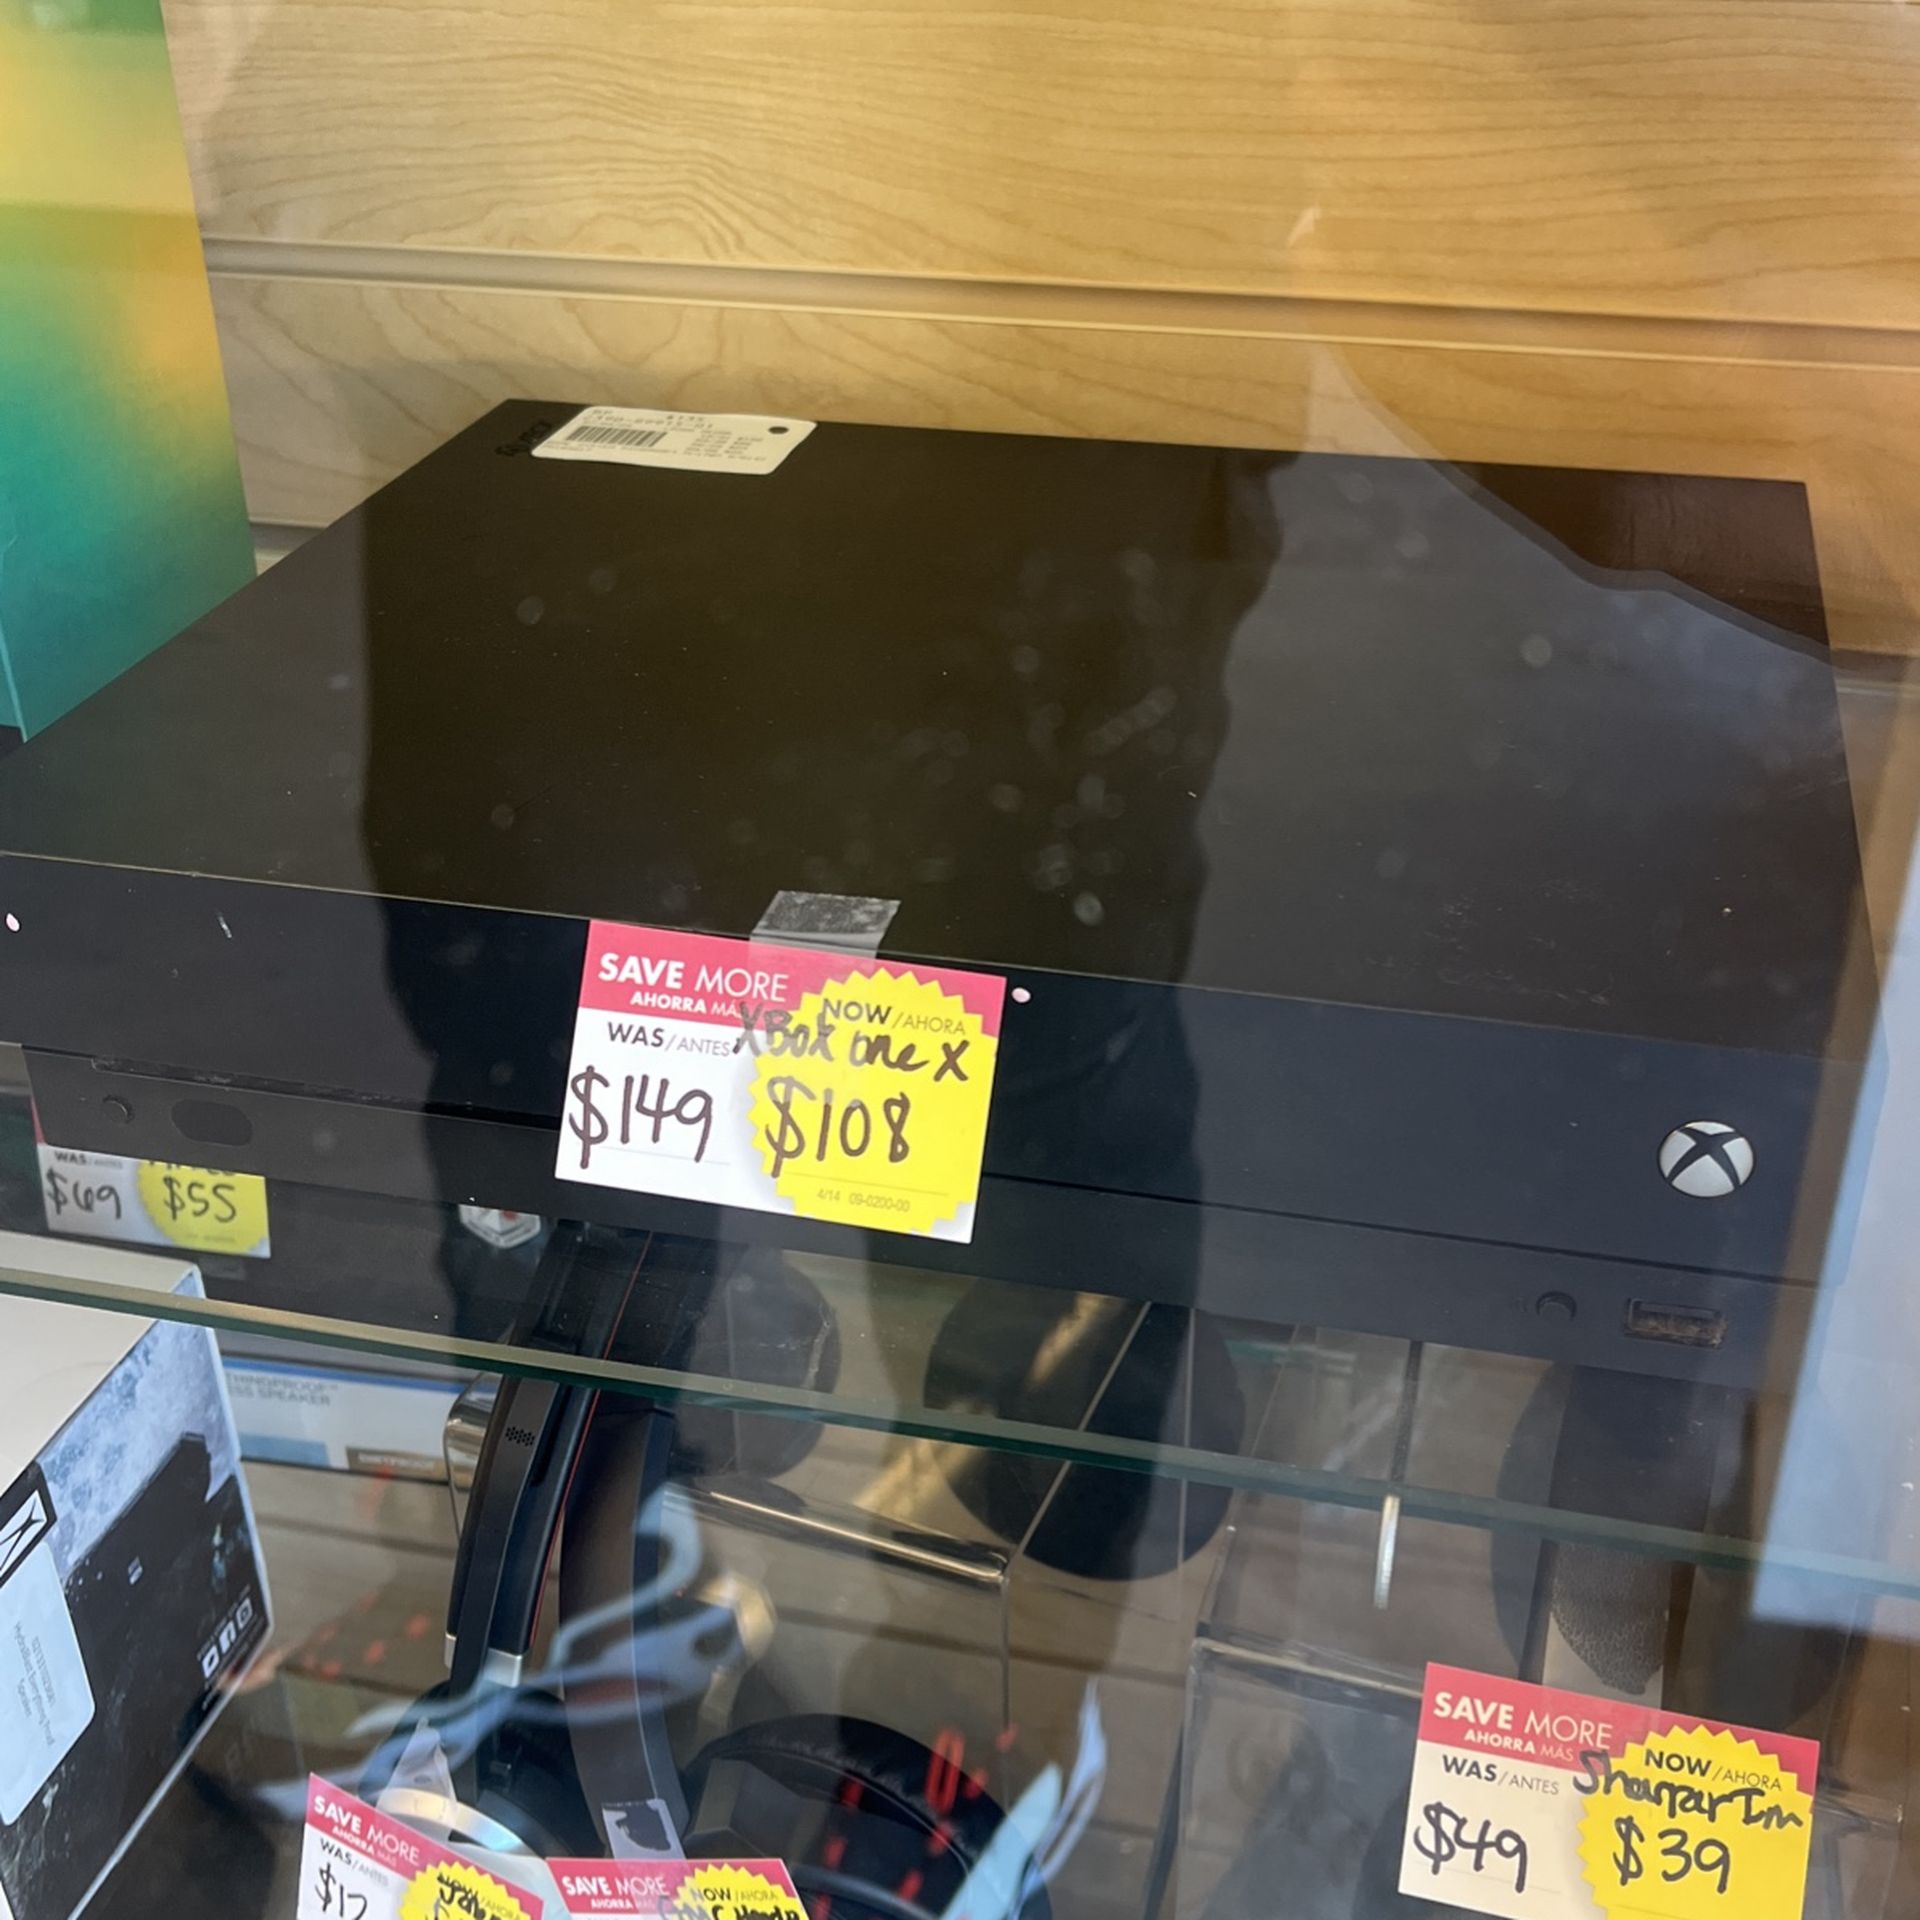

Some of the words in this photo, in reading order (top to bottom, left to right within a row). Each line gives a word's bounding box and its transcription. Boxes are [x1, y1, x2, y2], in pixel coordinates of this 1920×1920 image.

[598, 951, 685, 990] SAVE
[695, 963, 790, 1003] MORE
[630, 989, 707, 1015] AHORRA
[711, 998, 745, 1019] MÁ
[849, 1030, 930, 1072] one
[933, 1040, 970, 1082] X
[569, 1065, 714, 1169] $149
[765, 1076, 911, 1178] $108
[46, 1168, 122, 1220] $69
[162, 1175, 237, 1223] $55
[1433, 1691, 1515, 1731] SAVE
[1524, 1708, 1615, 1751] MORE
[1463, 1729, 1536, 1756] AHORRA
[1540, 1741, 1575, 1763] MÁS
[314, 1795, 363, 1835] SAVE
[366, 1823, 420, 1867] MORE
[1413, 1801, 1528, 1893] $49
[1612, 1816, 1731, 1894] $39
[561, 1876, 613, 1897] SAVE
[614, 1876, 671, 1896] MORE
